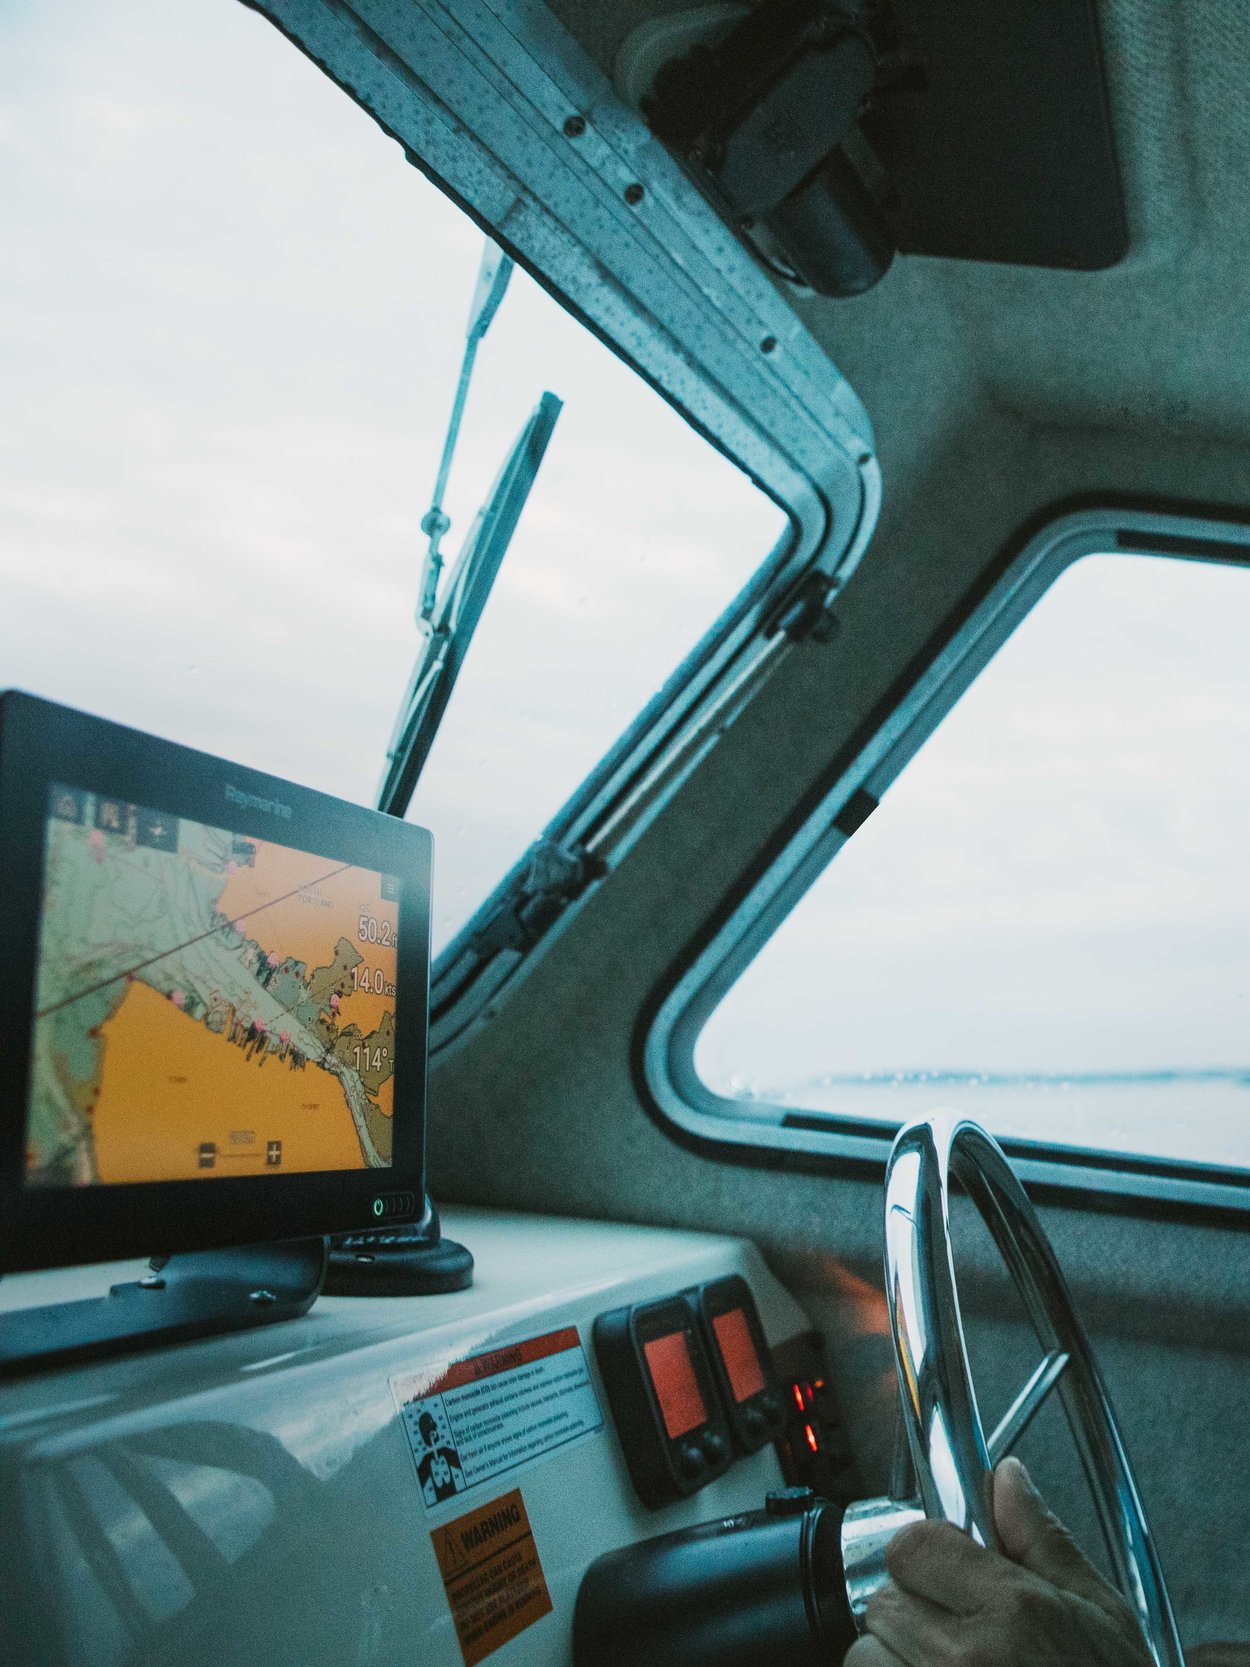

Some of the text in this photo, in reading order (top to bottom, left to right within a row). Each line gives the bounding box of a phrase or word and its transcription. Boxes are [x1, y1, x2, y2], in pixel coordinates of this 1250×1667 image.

[358, 915, 391, 946] 50.2
[351, 966, 385, 995] 14.0
[460, 1503, 521, 1551] WARNING
